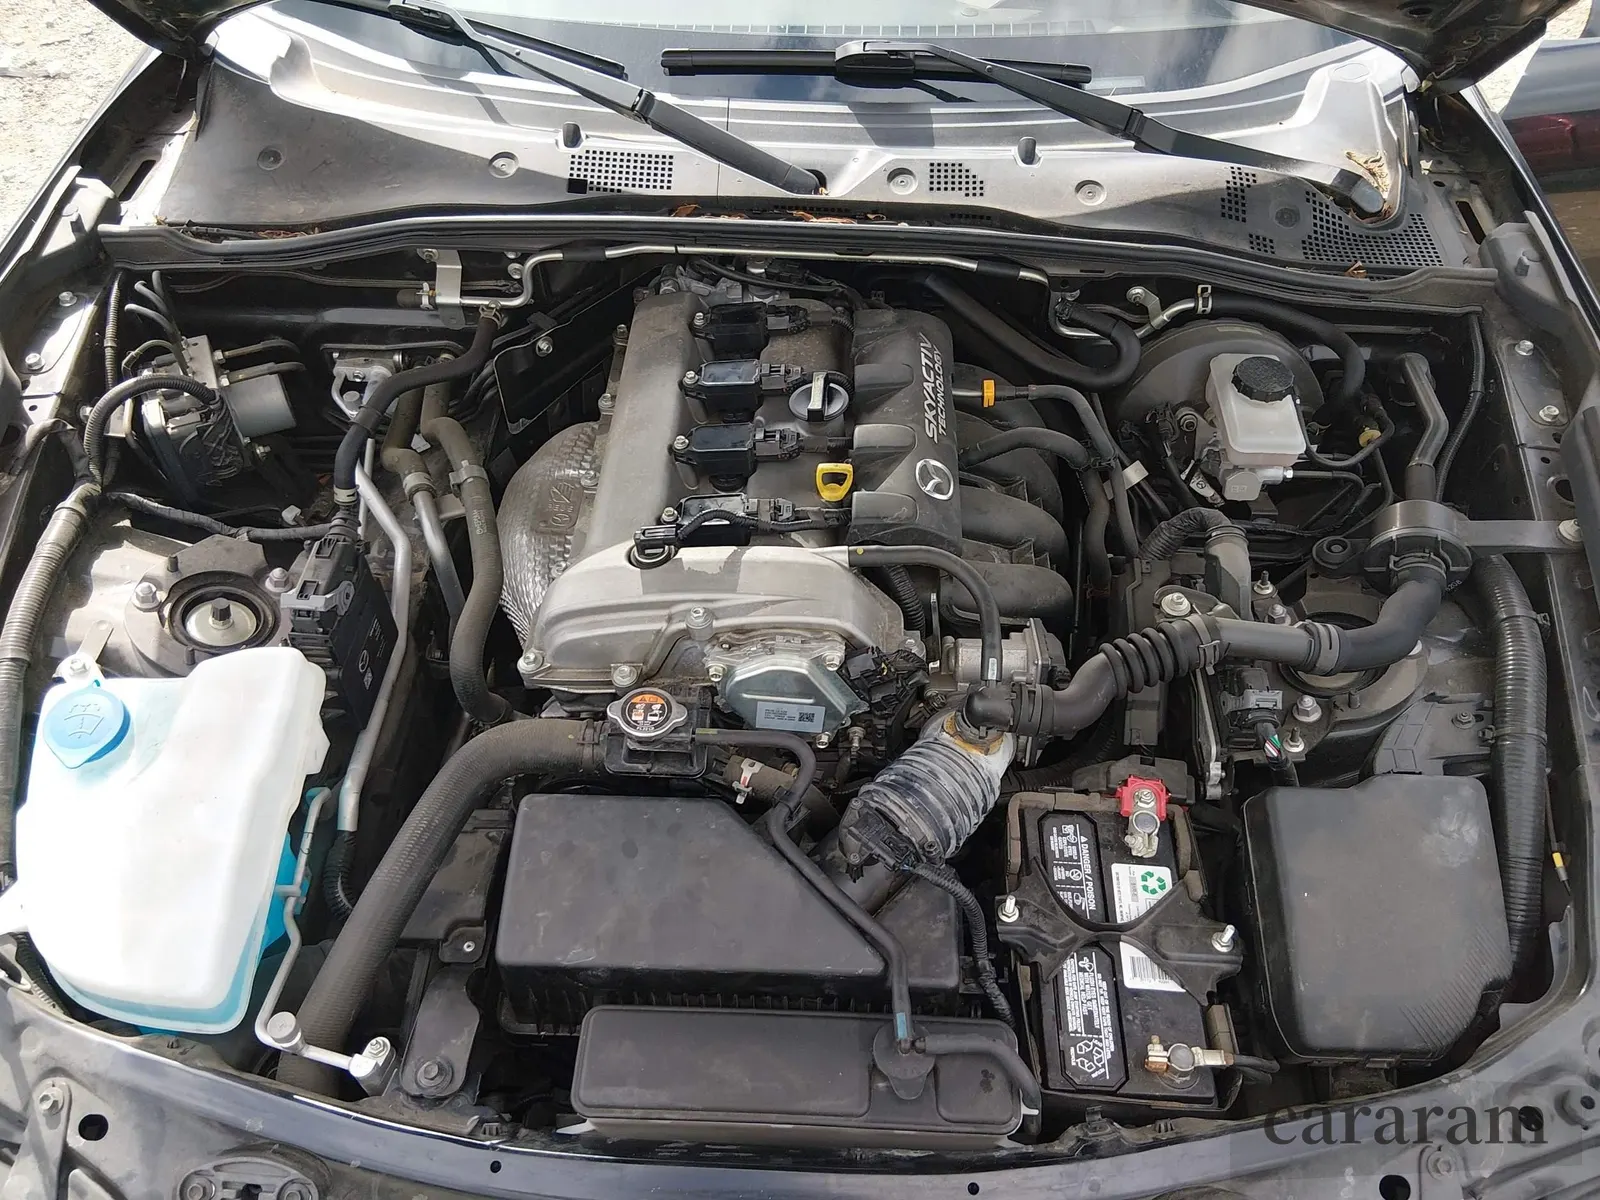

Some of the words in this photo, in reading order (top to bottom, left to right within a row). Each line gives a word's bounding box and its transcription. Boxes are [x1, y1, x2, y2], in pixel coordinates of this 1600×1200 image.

[920, 332, 938, 444] SKYACTIV
[933, 344, 947, 435] TECHNOLOGY
[1082, 843, 1091, 874] DANGER
[1086, 881, 1095, 910] POISON
